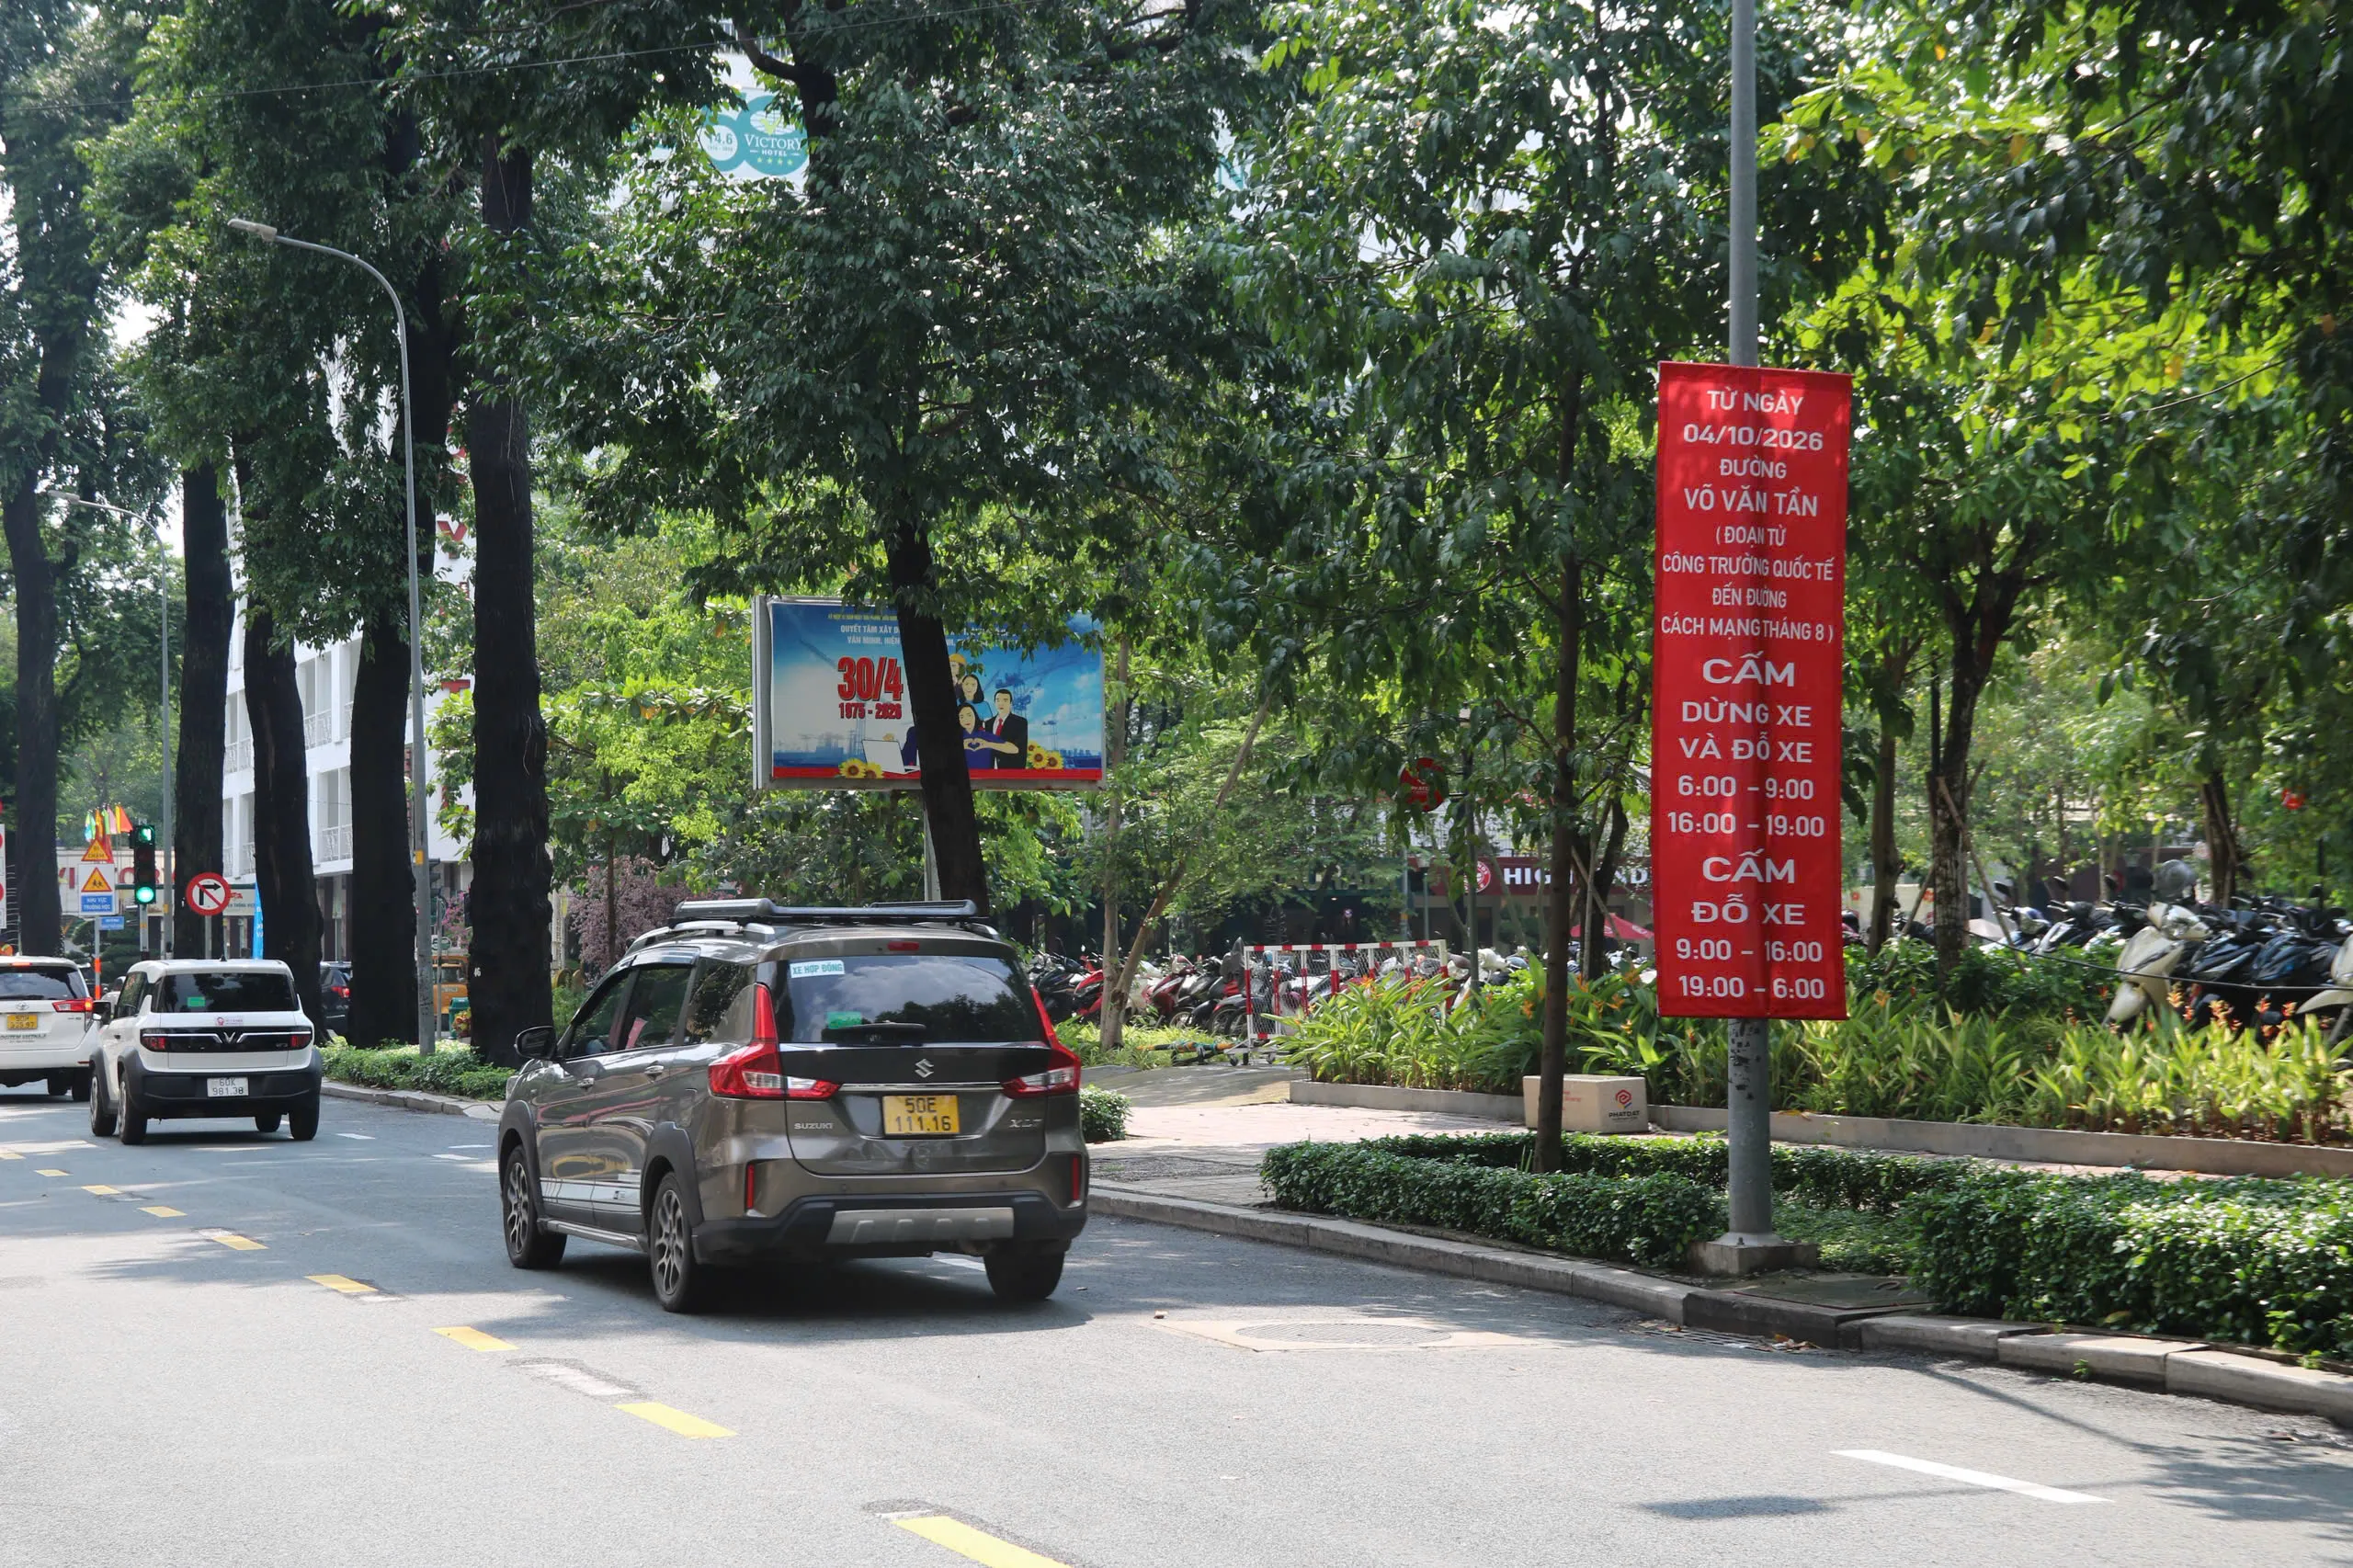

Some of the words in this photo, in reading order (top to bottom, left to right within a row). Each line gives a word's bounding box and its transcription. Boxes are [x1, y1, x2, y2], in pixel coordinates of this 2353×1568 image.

[744, 133, 804, 151] VICTORY
[1707, 387, 1737, 410] TỪ
[1744, 390, 1805, 415] NGÀY
[1683, 424, 1824, 450] 04/10/2026
[1720, 458, 1787, 479] ĐƯỜNG
[1684, 483, 1715, 510] VÕ
[1722, 485, 1768, 513] VĂN
[1774, 486, 1818, 517] TẦN
[1662, 551, 1705, 574] CÔNG
[1709, 553, 1769, 576] TRƯỜNG
[1772, 554, 1812, 579] QUỐC
[1815, 556, 1835, 581] TẾ
[1712, 581, 1742, 606] ĐẾN
[1661, 612, 1704, 636] CÁCH
[1710, 618, 1761, 642] MẠNG
[1763, 616, 1811, 641] THÁNG
[837, 655, 904, 701] 30/4
[1702, 651, 1795, 687] CẤM
[839, 702, 866, 719] 1975
[1682, 696, 1769, 723] DỪNG
[1777, 705, 1812, 727] XE
[1678, 733, 1722, 759] VÀ
[1732, 732, 1770, 760] ĐỖ
[1778, 742, 1813, 763] XE
[1677, 775, 1736, 797] 6:00
[1765, 778, 1813, 800] 9:00
[1667, 812, 1736, 834] 16:00
[1766, 814, 1824, 837] 19:00
[1702, 848, 1795, 883] CẤM
[1691, 893, 1749, 923] ĐỖ
[1762, 903, 1805, 926] XE
[1676, 937, 1732, 960] 9:00
[1765, 940, 1823, 962] 16:00
[1678, 975, 1745, 997] 19:00
[1772, 978, 1824, 999] 6:00
[220, 1078, 236, 1086] 60K
[904, 1097, 937, 1114] 50E
[794, 1122, 834, 1131] SUZUKI
[895, 1115, 952, 1132] 111.16
